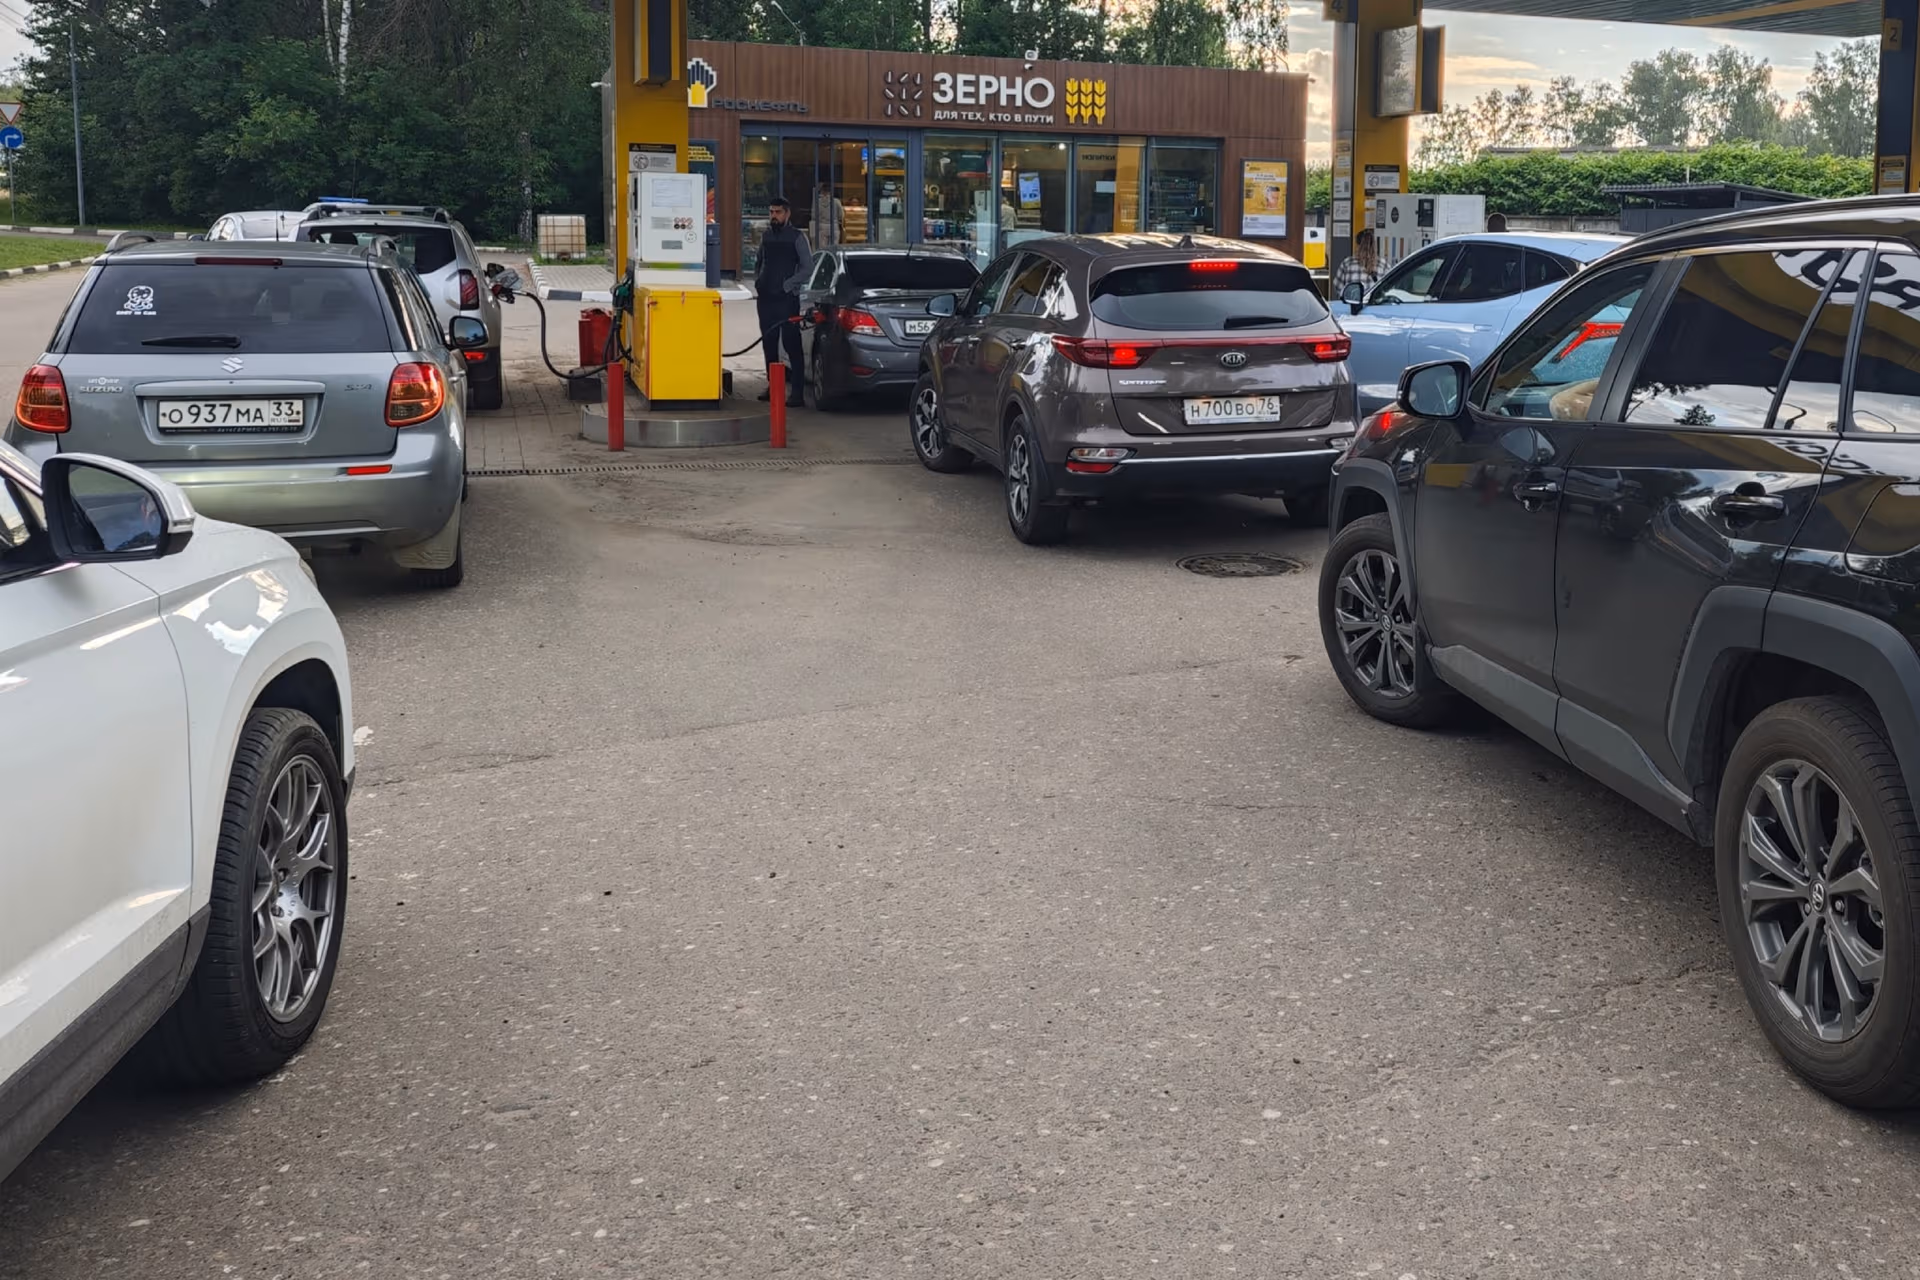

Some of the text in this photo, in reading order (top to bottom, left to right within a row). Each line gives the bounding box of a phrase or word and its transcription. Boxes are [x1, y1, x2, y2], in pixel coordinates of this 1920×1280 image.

[1889, 27, 1898, 42] 2
[932, 71, 1056, 109] ЗЕРНО
[712, 98, 809, 113] РОСНЕФТЬ
[934, 110, 1054, 123] ДЛЯ ТЕХ, КТО В ПУТИ
[79, 385, 124, 393] SUZUKI
[272, 401, 294, 417] 33
[1258, 397, 1275, 411] 76
